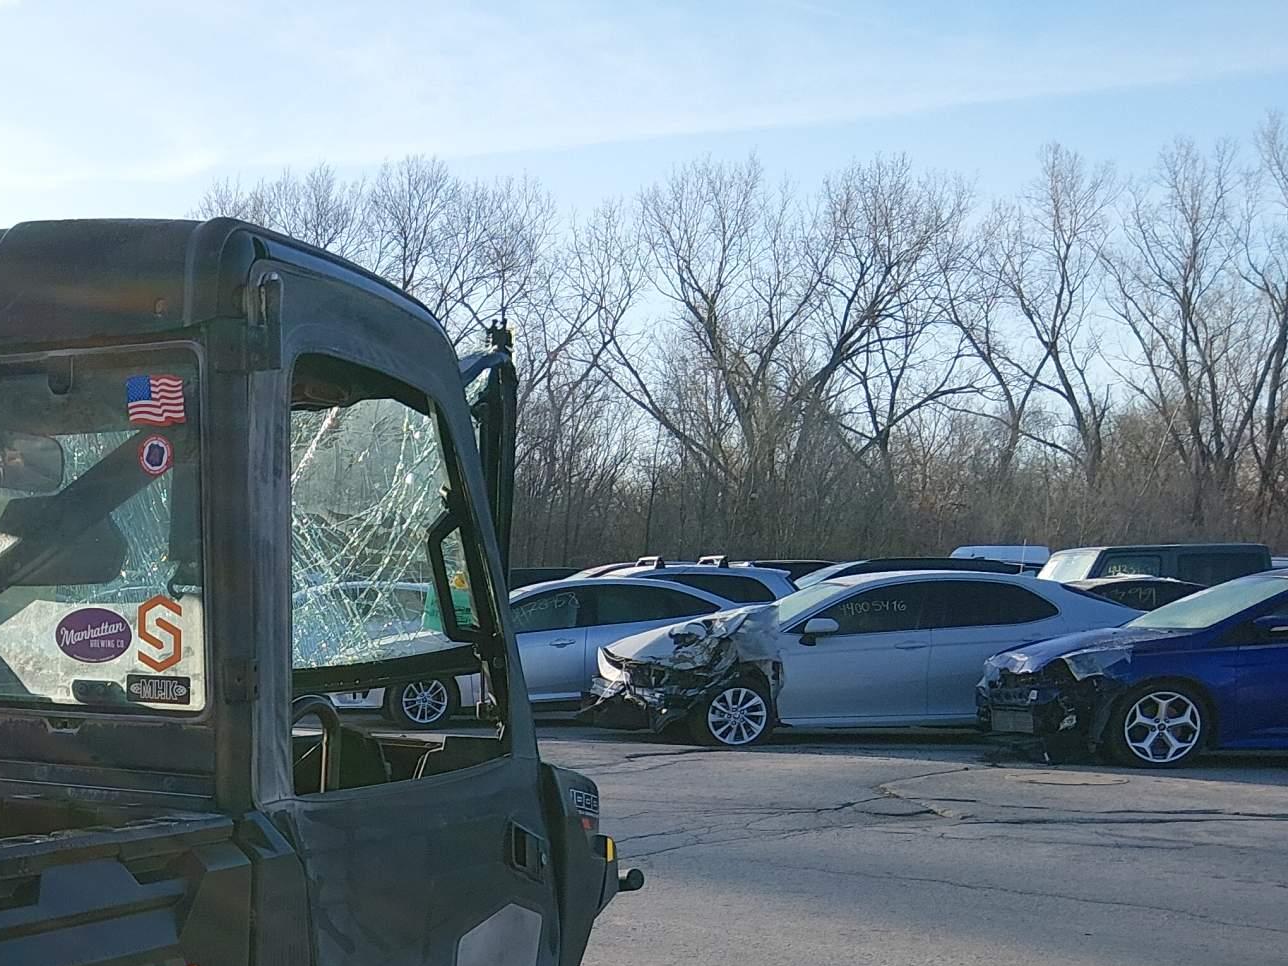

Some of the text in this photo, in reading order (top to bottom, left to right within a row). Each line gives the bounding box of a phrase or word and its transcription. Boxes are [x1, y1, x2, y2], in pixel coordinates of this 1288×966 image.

[60, 621, 126, 647] Manhattan
[89, 639, 115, 649] BREWING
[140, 679, 178, 700] MHK
